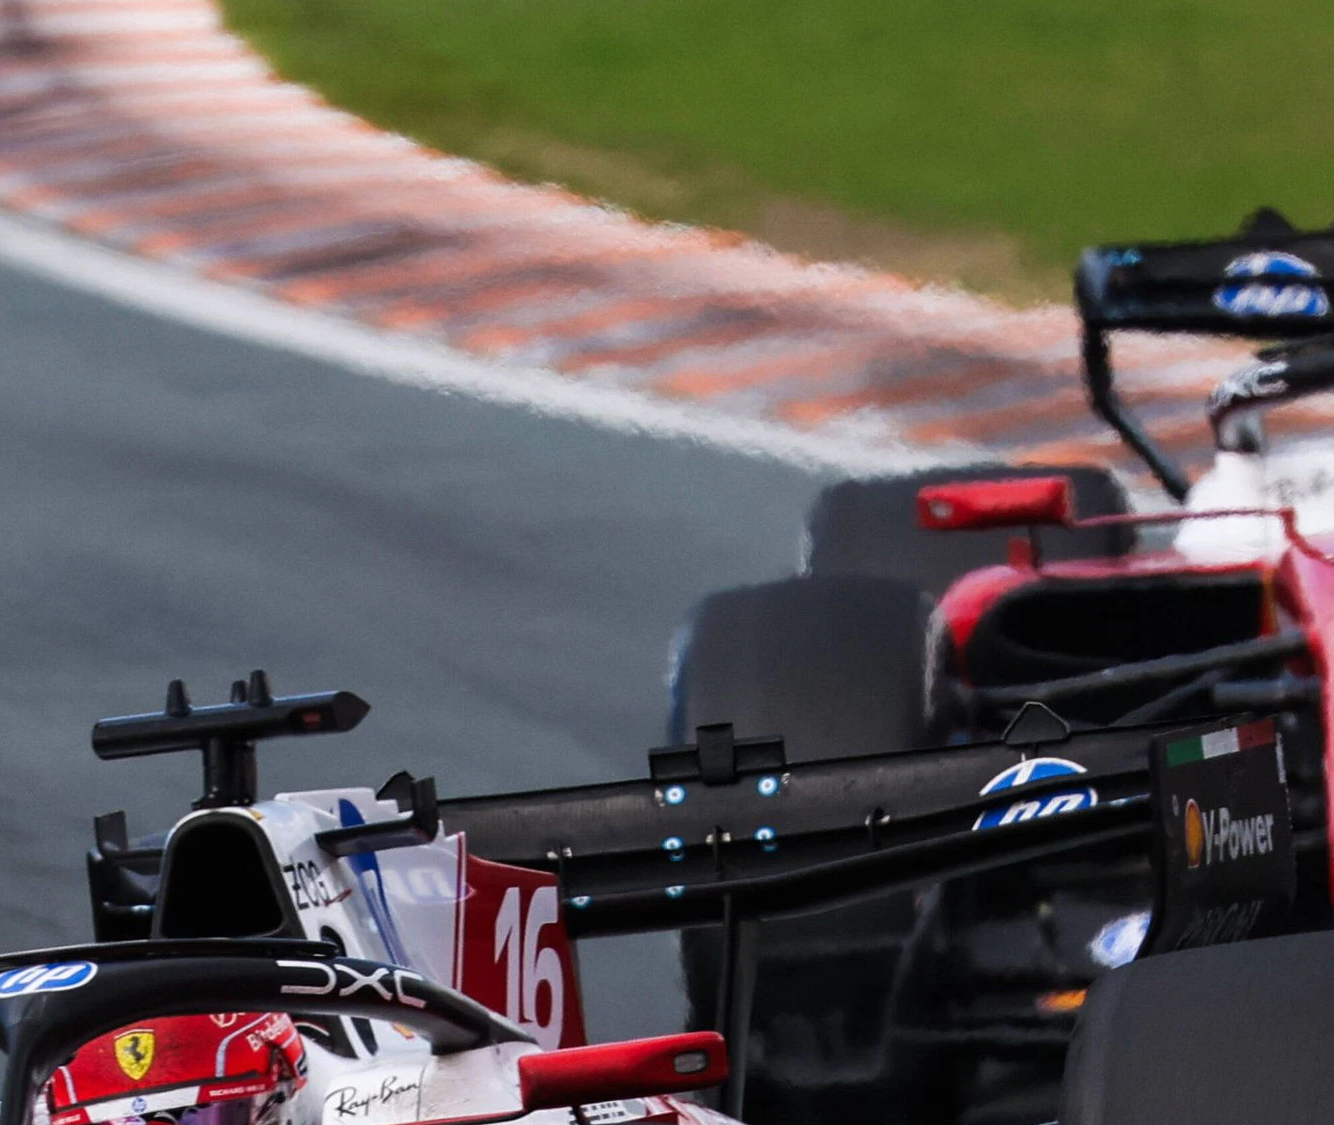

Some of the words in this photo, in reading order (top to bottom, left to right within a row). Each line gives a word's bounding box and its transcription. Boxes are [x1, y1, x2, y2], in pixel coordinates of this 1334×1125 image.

[1202, 806, 1274, 866] V-Power
[276, 959, 427, 1009] DXC
[494, 885, 564, 1052] 16
[325, 1075, 419, 1117] Ray-Ban
